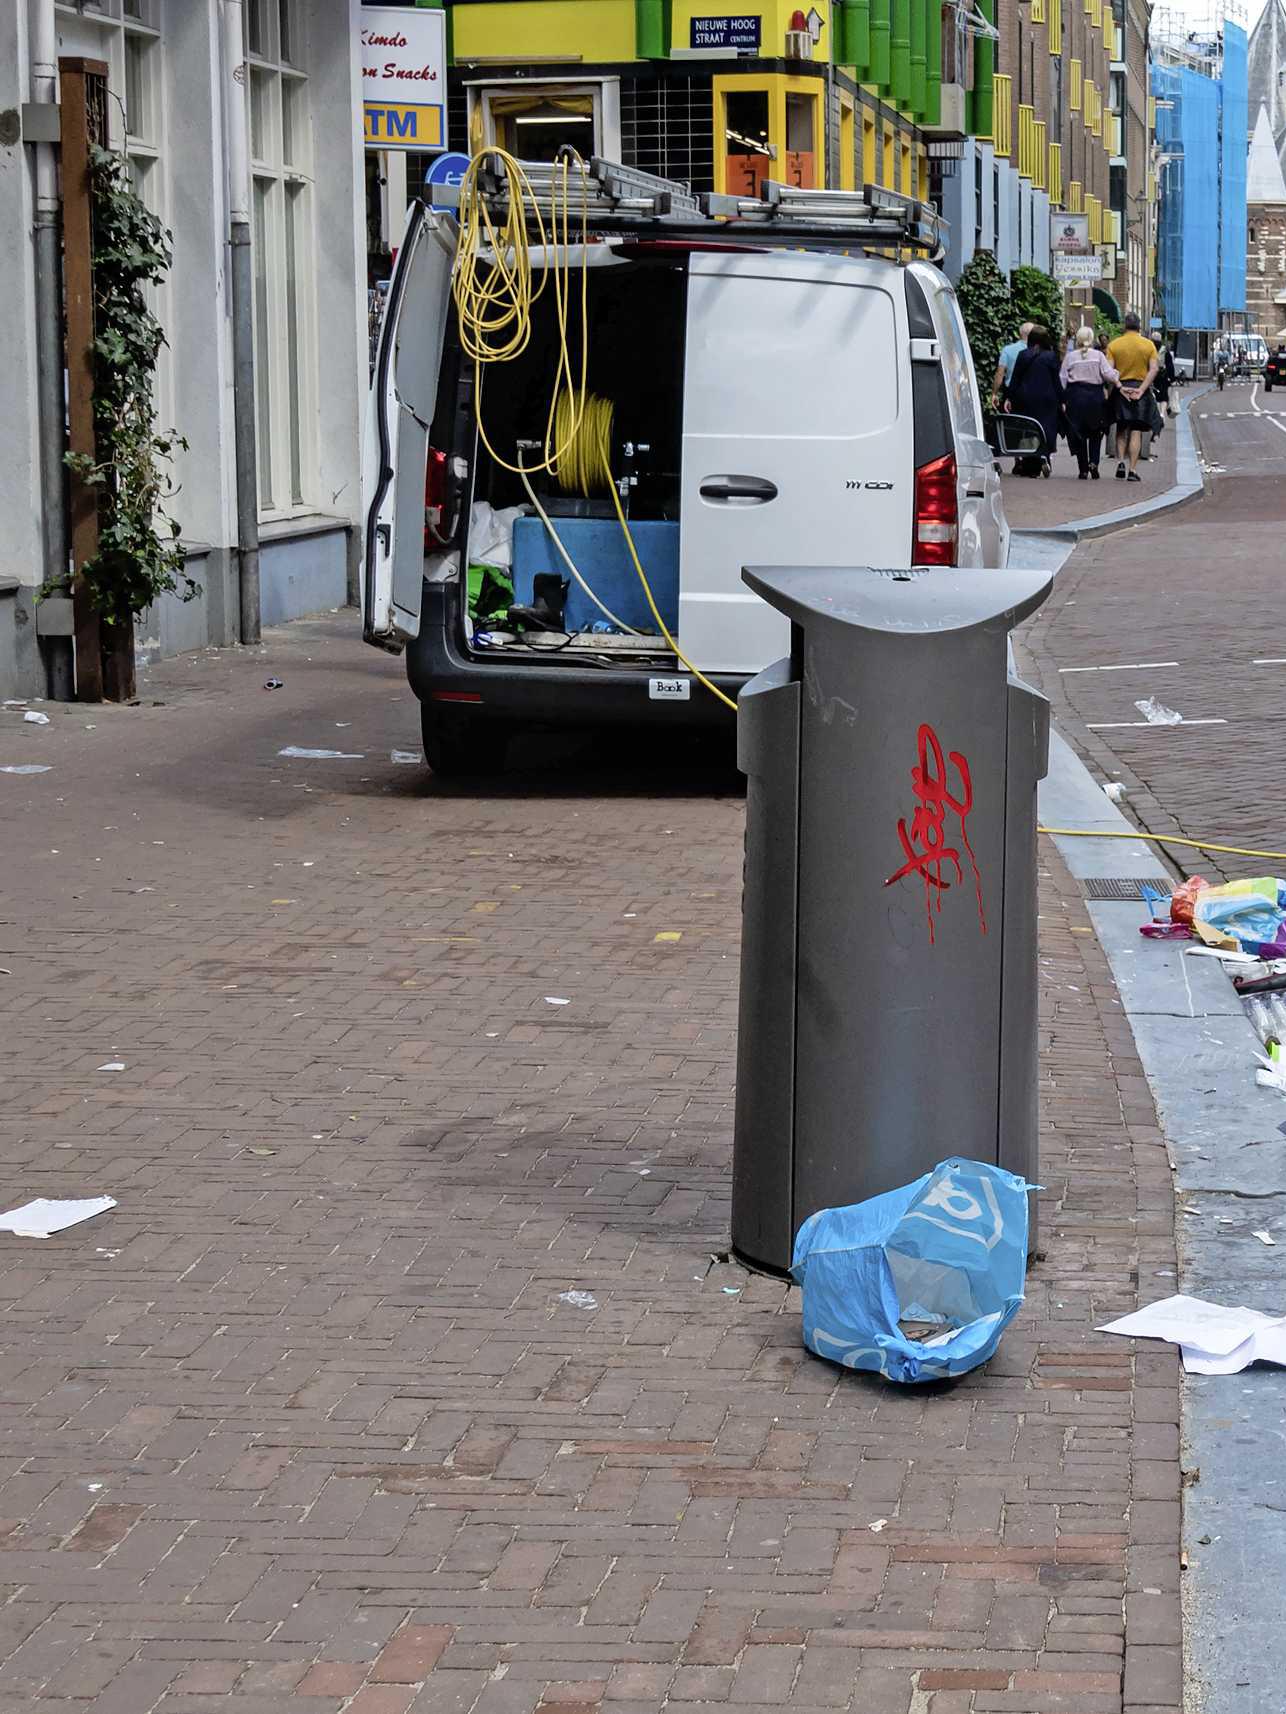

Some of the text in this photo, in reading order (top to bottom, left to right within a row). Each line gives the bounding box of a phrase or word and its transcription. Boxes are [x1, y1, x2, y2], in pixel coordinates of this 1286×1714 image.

[695, 19, 756, 31] NIEUWE HOOG
[695, 32, 756, 44] STRAAT CENTRUM
[382, 62, 437, 81] Snacks
[363, 109, 417, 138] TM
